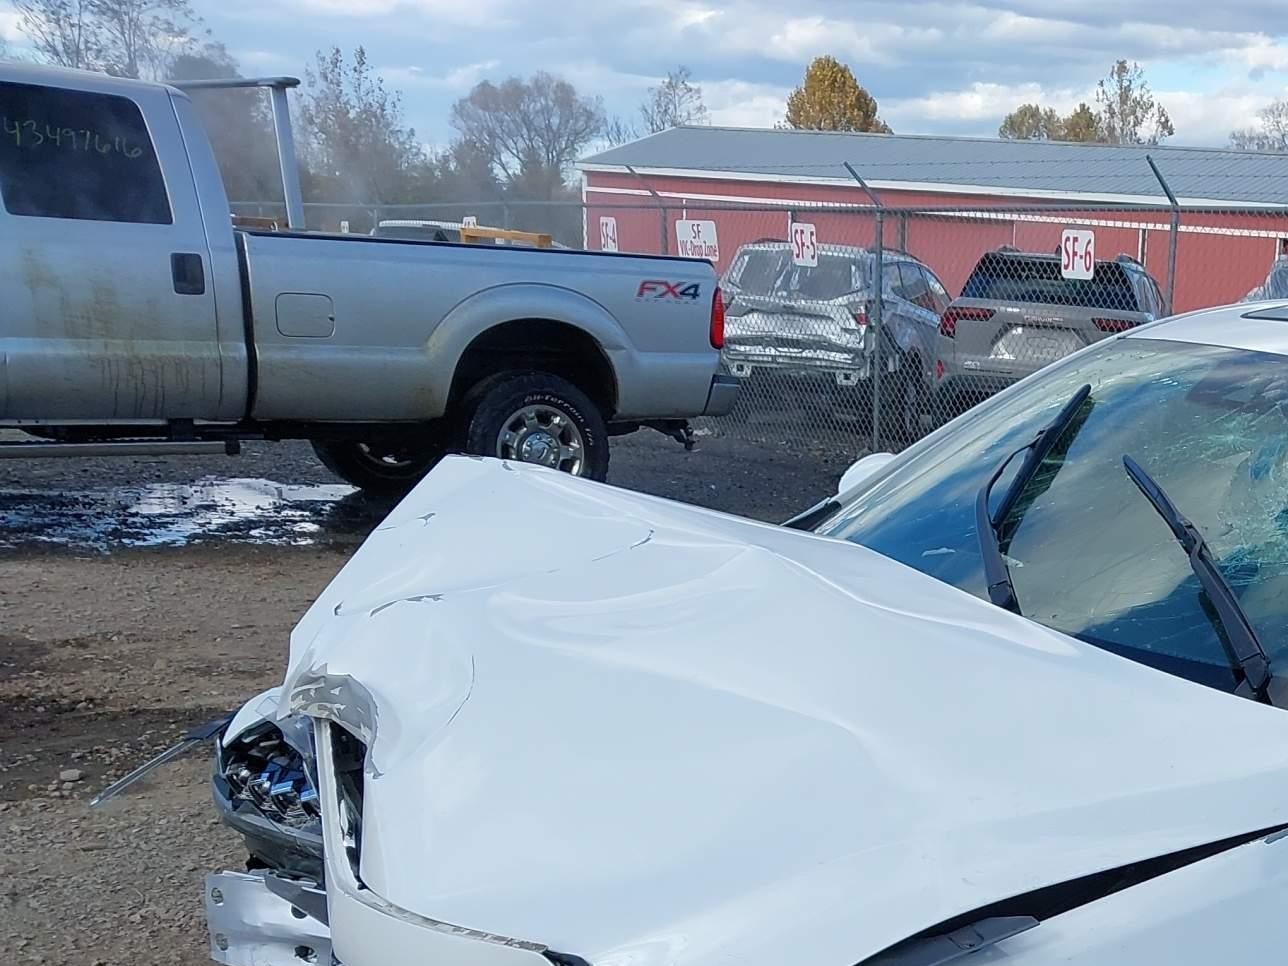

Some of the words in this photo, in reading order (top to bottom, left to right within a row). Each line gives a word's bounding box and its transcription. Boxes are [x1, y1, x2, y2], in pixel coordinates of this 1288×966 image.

[601, 221, 617, 247] SF-4
[691, 223, 702, 240] SF
[703, 240, 717, 257] Zone
[793, 228, 816, 260] SF-5
[1063, 235, 1092, 273] SF-6
[636, 279, 700, 300] FX4
